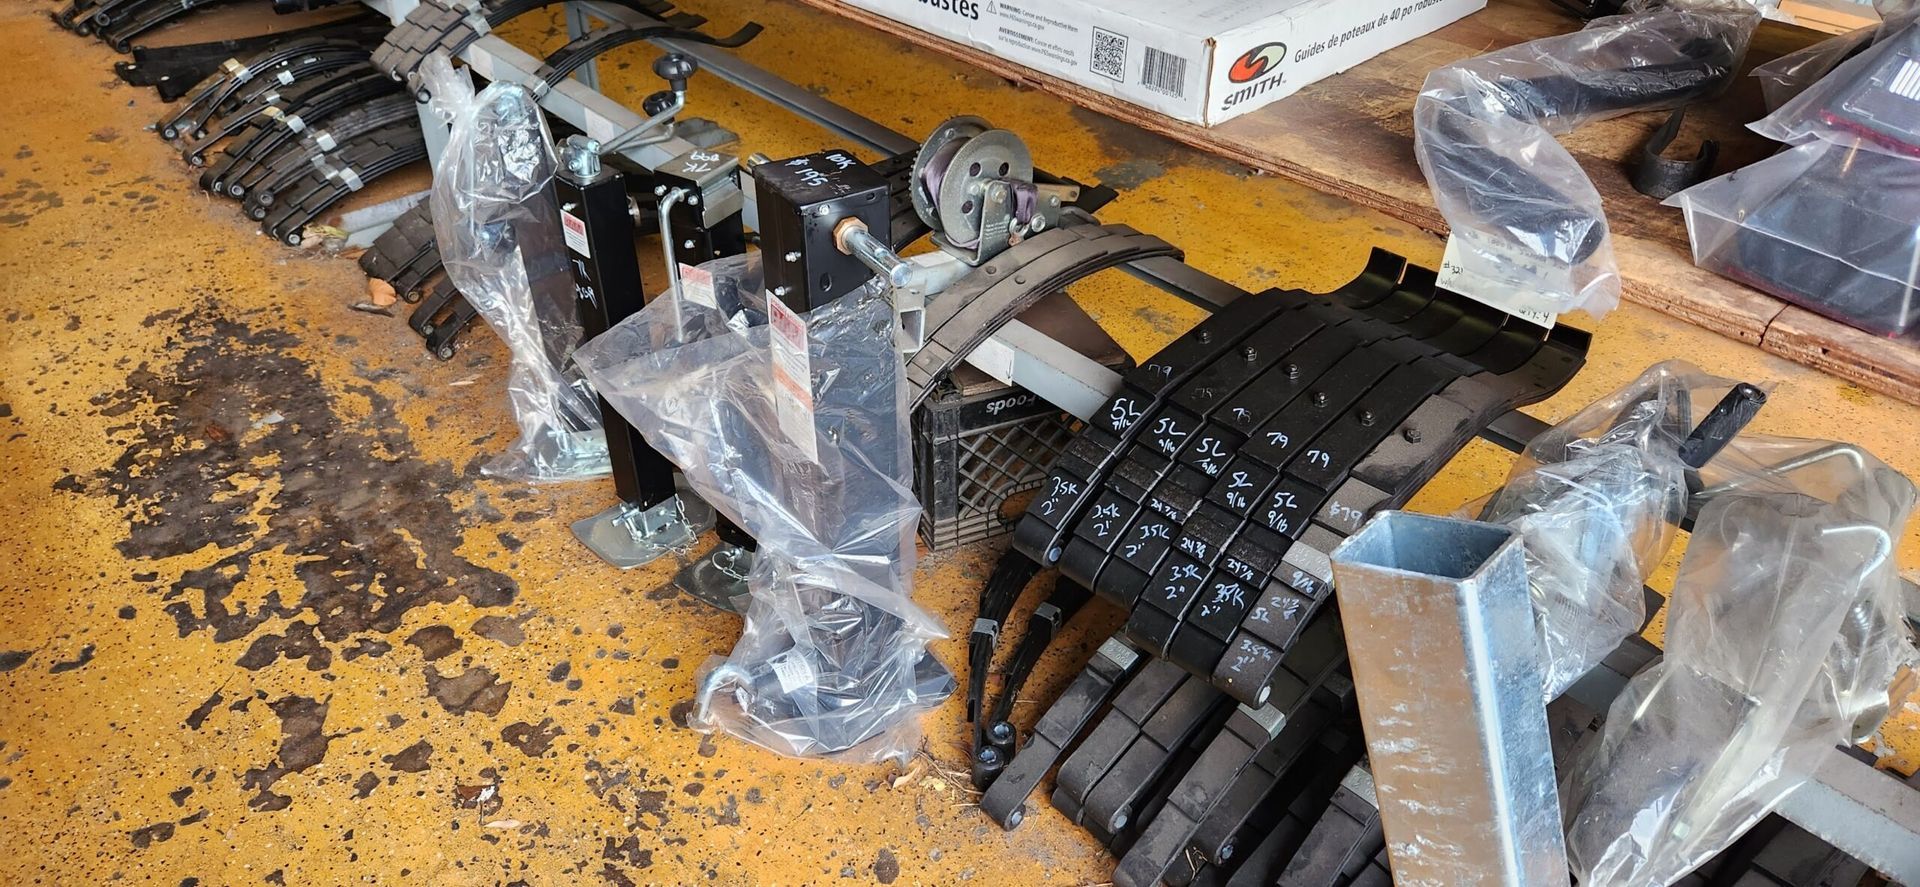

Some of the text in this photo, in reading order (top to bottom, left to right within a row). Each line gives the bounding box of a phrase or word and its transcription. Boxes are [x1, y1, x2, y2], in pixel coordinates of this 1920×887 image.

[1000, 3, 1021, 14] WARNING:
[1295, 42, 1325, 63] Guides
[1327, 34, 1339, 49] de
[1339, 18, 1376, 49] poteaux
[1377, 13, 1389, 27] de
[1390, 7, 1400, 21] 40
[1401, 5, 1412, 21] po
[1221, 72, 1283, 111] SMITH
[683, 161, 711, 173] 7K
[826, 154, 856, 169] 10K
[1149, 364, 1172, 381] 79
[1154, 417, 1187, 436] 5L
[1196, 438, 1226, 458] 5L
[1266, 432, 1289, 449] 79
[1307, 450, 1330, 468] 79
[1228, 471, 1253, 487] 5L
[1274, 491, 1298, 509] 5L
[1267, 510, 1288, 533] 9/16
